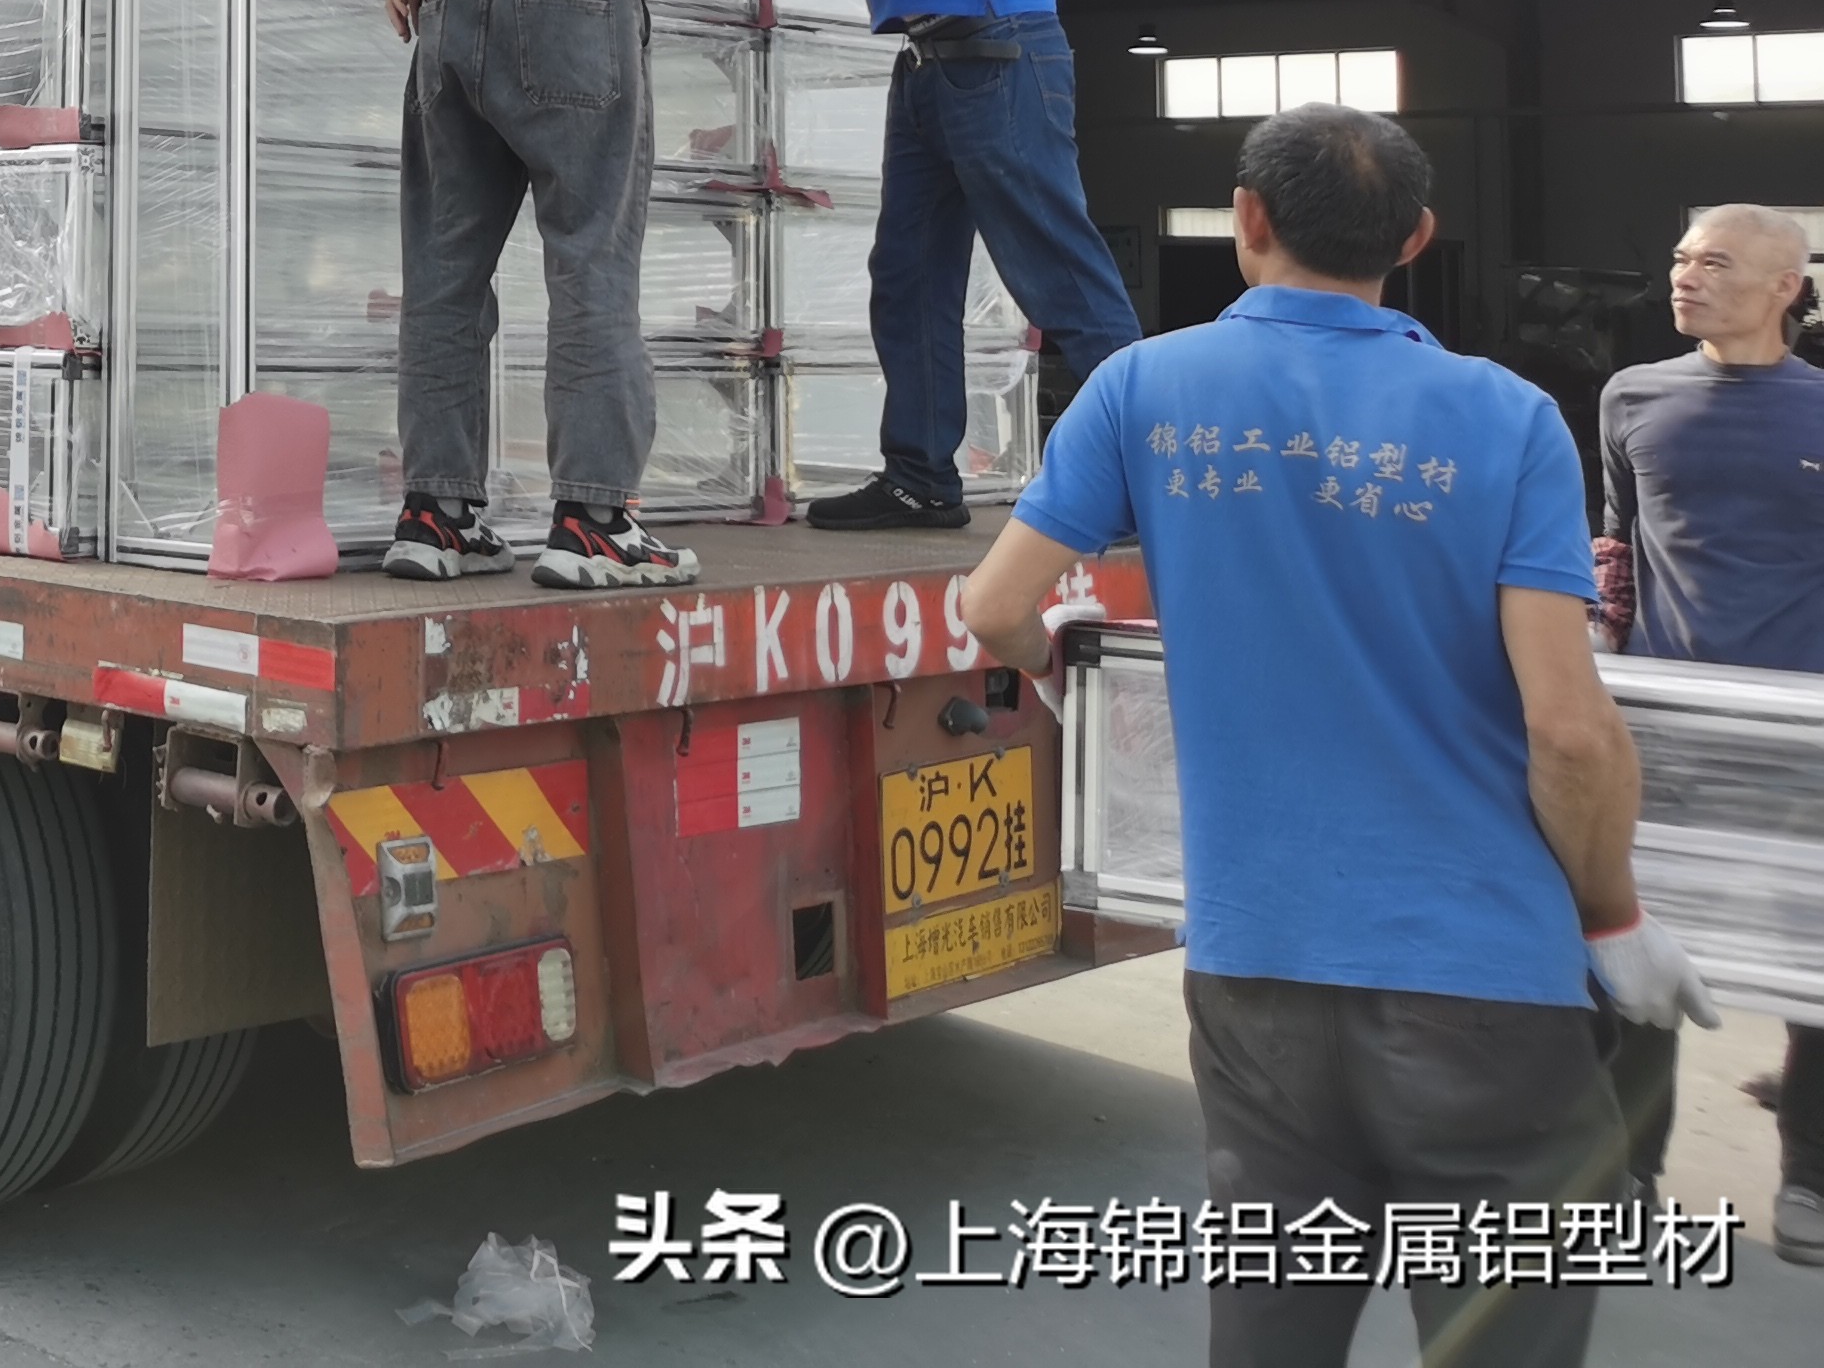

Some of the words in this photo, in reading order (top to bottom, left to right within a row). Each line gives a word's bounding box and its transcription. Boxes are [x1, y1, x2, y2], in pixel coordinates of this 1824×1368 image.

[1146, 421, 1458, 495] 锦铝工业铝型材
[1165, 464, 1264, 501] 更专业
[1311, 475, 1434, 523] 更省心
[890, 800, 1027, 900] 0992挂
